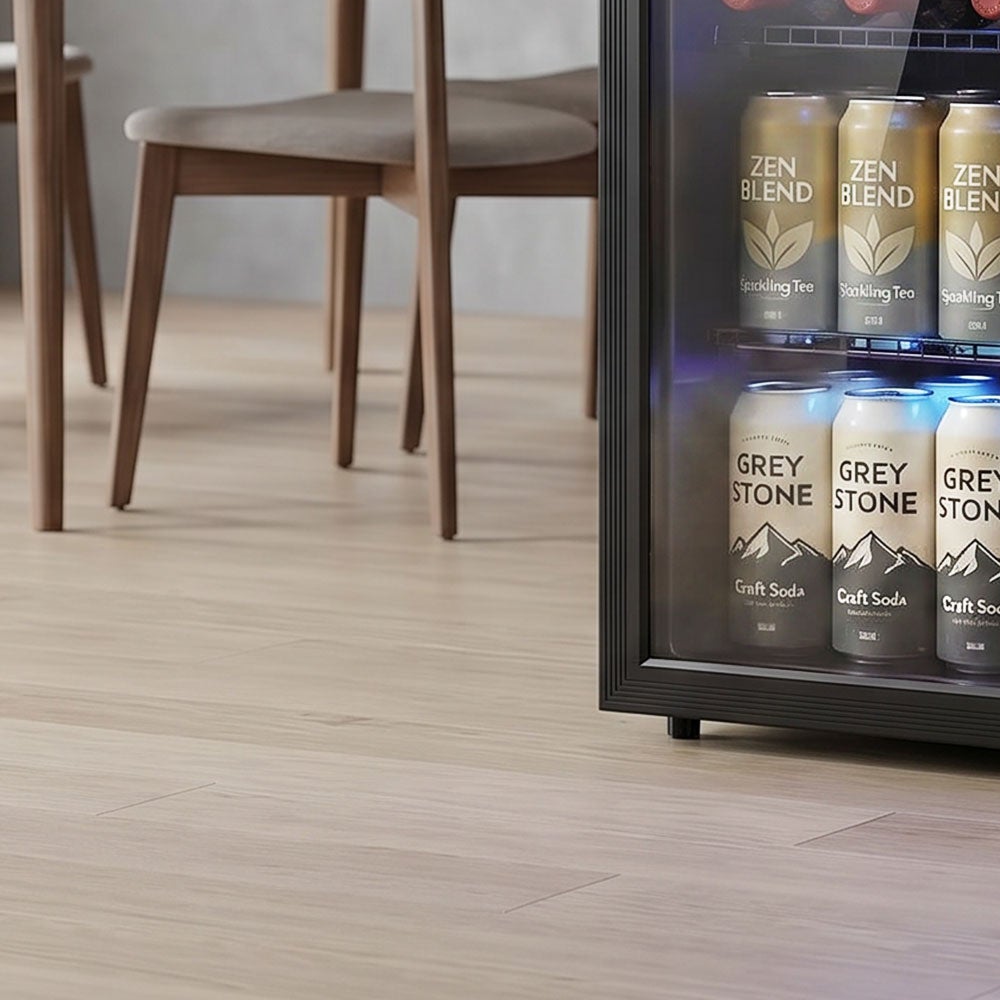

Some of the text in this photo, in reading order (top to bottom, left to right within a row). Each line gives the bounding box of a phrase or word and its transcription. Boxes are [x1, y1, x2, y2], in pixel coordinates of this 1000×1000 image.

[750, 155, 796, 178] ZEN
[850, 160, 897, 182] ZEN
[953, 164, 1000, 187] ZEN
[741, 179, 813, 203] BLEND
[841, 183, 915, 208] BLEND
[737, 453, 804, 477] GREY
[839, 460, 908, 485] GREY
[733, 481, 813, 506] STONE
[834, 488, 918, 515] STONE
[769, 582, 805, 598] Soda
